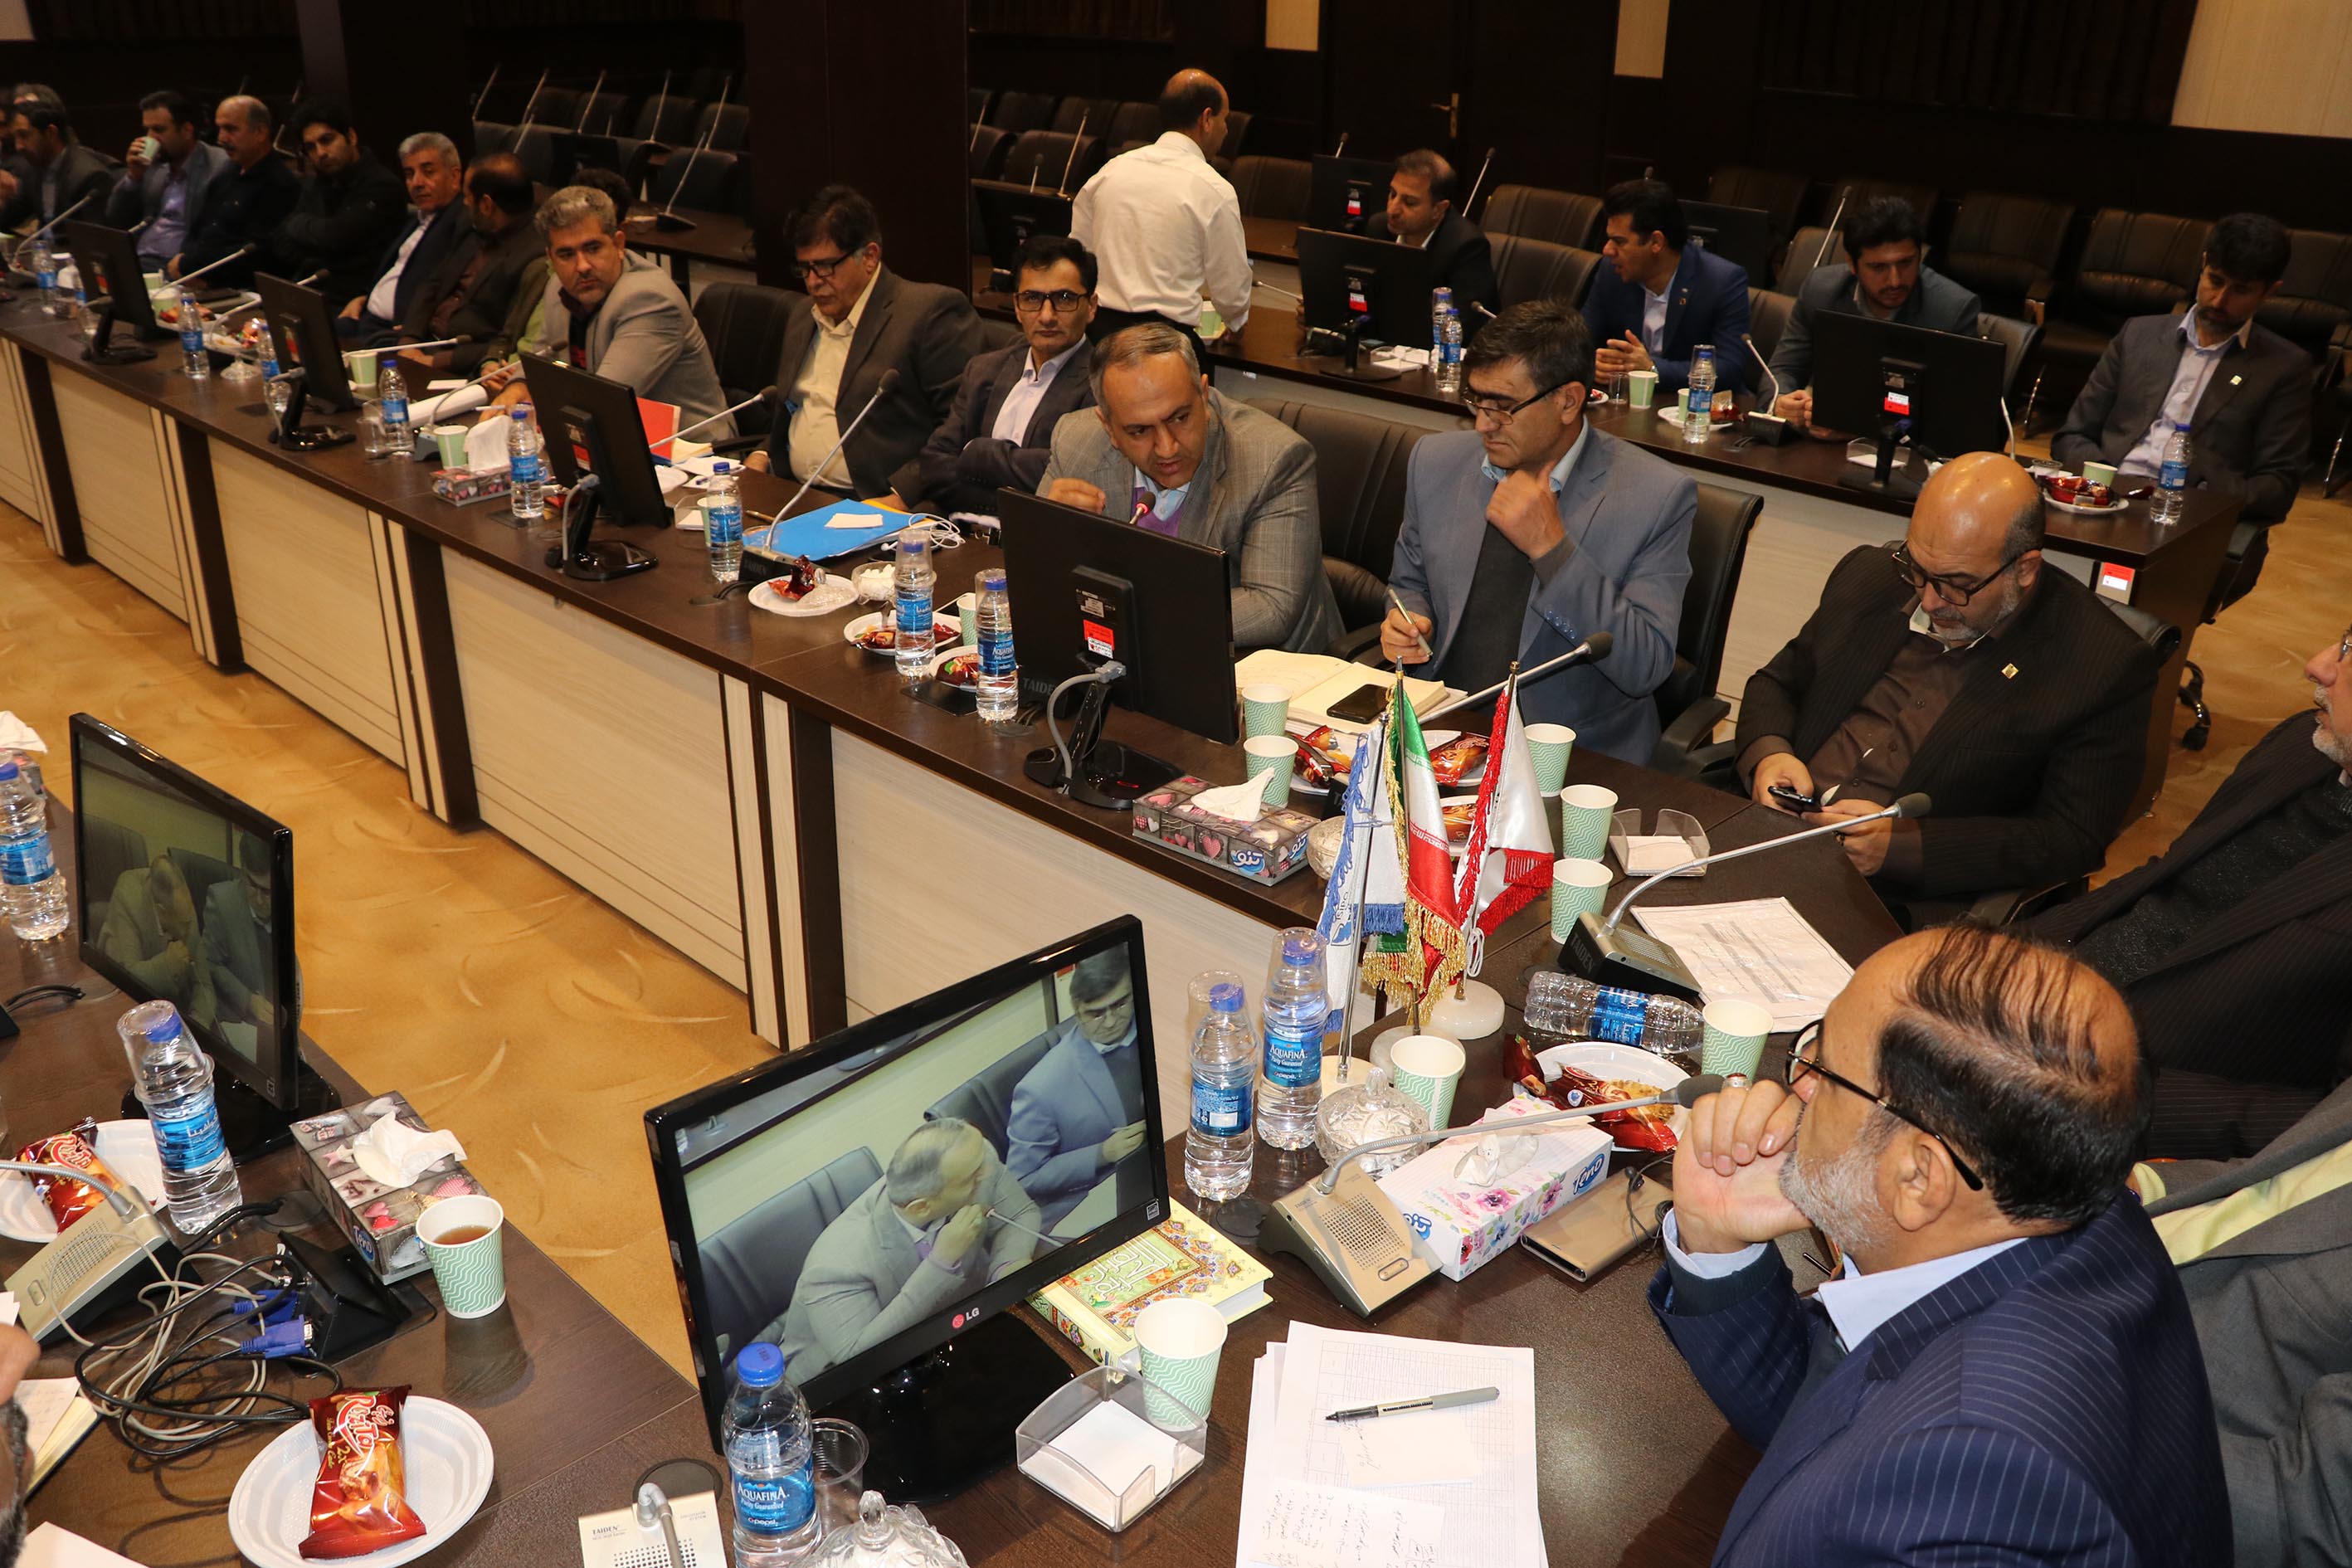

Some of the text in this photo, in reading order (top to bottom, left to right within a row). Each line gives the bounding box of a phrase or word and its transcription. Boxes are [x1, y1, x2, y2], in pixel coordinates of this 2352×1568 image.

[1270, 1044, 1306, 1059] AQUAFINA
[966, 1307, 981, 1322] LG
[738, 1482, 787, 1501] AQUAFINA
[754, 1517, 778, 1527] pepsi
